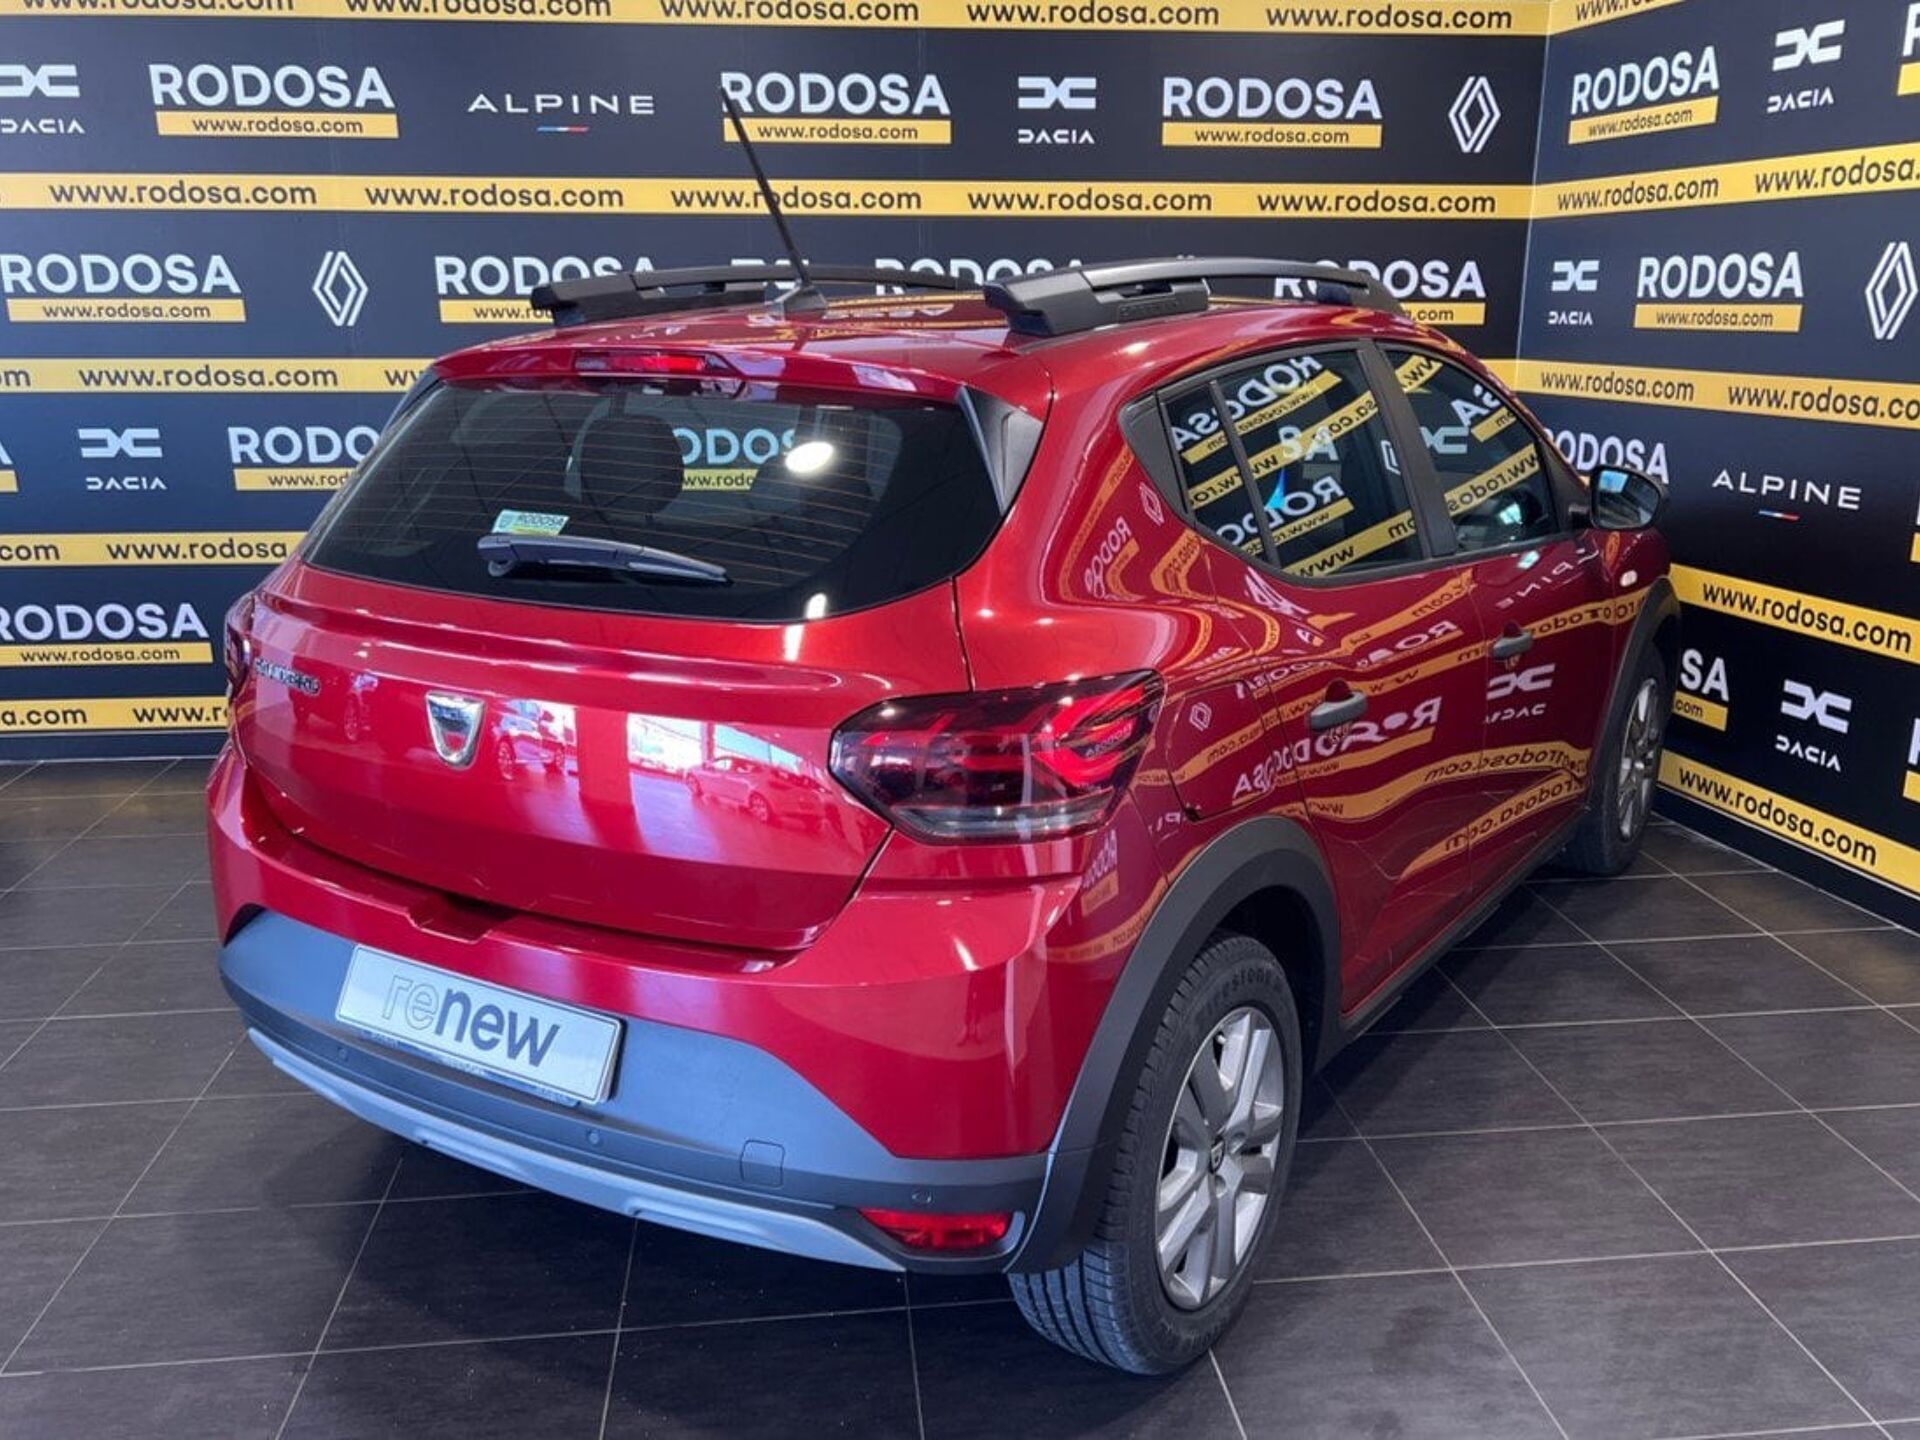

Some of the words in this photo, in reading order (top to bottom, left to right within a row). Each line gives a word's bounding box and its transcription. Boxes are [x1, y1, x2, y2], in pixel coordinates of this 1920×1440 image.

[663, 0, 918, 21] www.rodosa.com
[968, 0, 1219, 25] www.rodosa.com
[1267, 5, 1513, 29] www.rodosa.com
[149, 64, 395, 108] RODOSA
[1570, 46, 1720, 115] RODOSA
[467, 93, 655, 115] ALPINE
[720, 72, 951, 115] RODOSA
[1163, 77, 1382, 119] RODOSA
[1767, 87, 1834, 113] DACIA
[0, 118, 86, 134] DACIA
[192, 117, 363, 134] www.rodosa.com
[757, 124, 918, 140] www.rodosa.com
[1588, 108, 1692, 137] www.rodosa.com
[1018, 129, 1095, 144] DACIA
[1194, 127, 1349, 143] www.rodosa.com
[49, 180, 317, 204] www.rodosa.com
[365, 184, 624, 207] www.rodosa.com
[968, 188, 1213, 211] www.rodosa.com
[1258, 190, 1495, 213] www.rodosa.com
[1558, 176, 1719, 211] www.rodosa.com
[0, 253, 242, 294] RODOSA
[1636, 251, 1804, 299] RODOSA
[42, 303, 211, 318] www.rodosa.com
[1547, 311, 1593, 326] DACIA
[1655, 308, 1774, 328] www.rodosa.com
[78, 364, 338, 386] www.rodosa.com
[1541, 371, 1694, 401] www.rodosa.com
[86, 477, 167, 490] DACIA
[1712, 469, 1862, 511] ALPINE
[1703, 583, 1912, 653] www.rodosa.com
[20, 647, 181, 663] www.rodosa.com
[1680, 648, 1729, 702] SA
[133, 706, 228, 723] www.r
[1775, 734, 1842, 773] DACIA
[1679, 767, 1877, 867] www.rodosa.com
[382, 975, 561, 1068] renew
